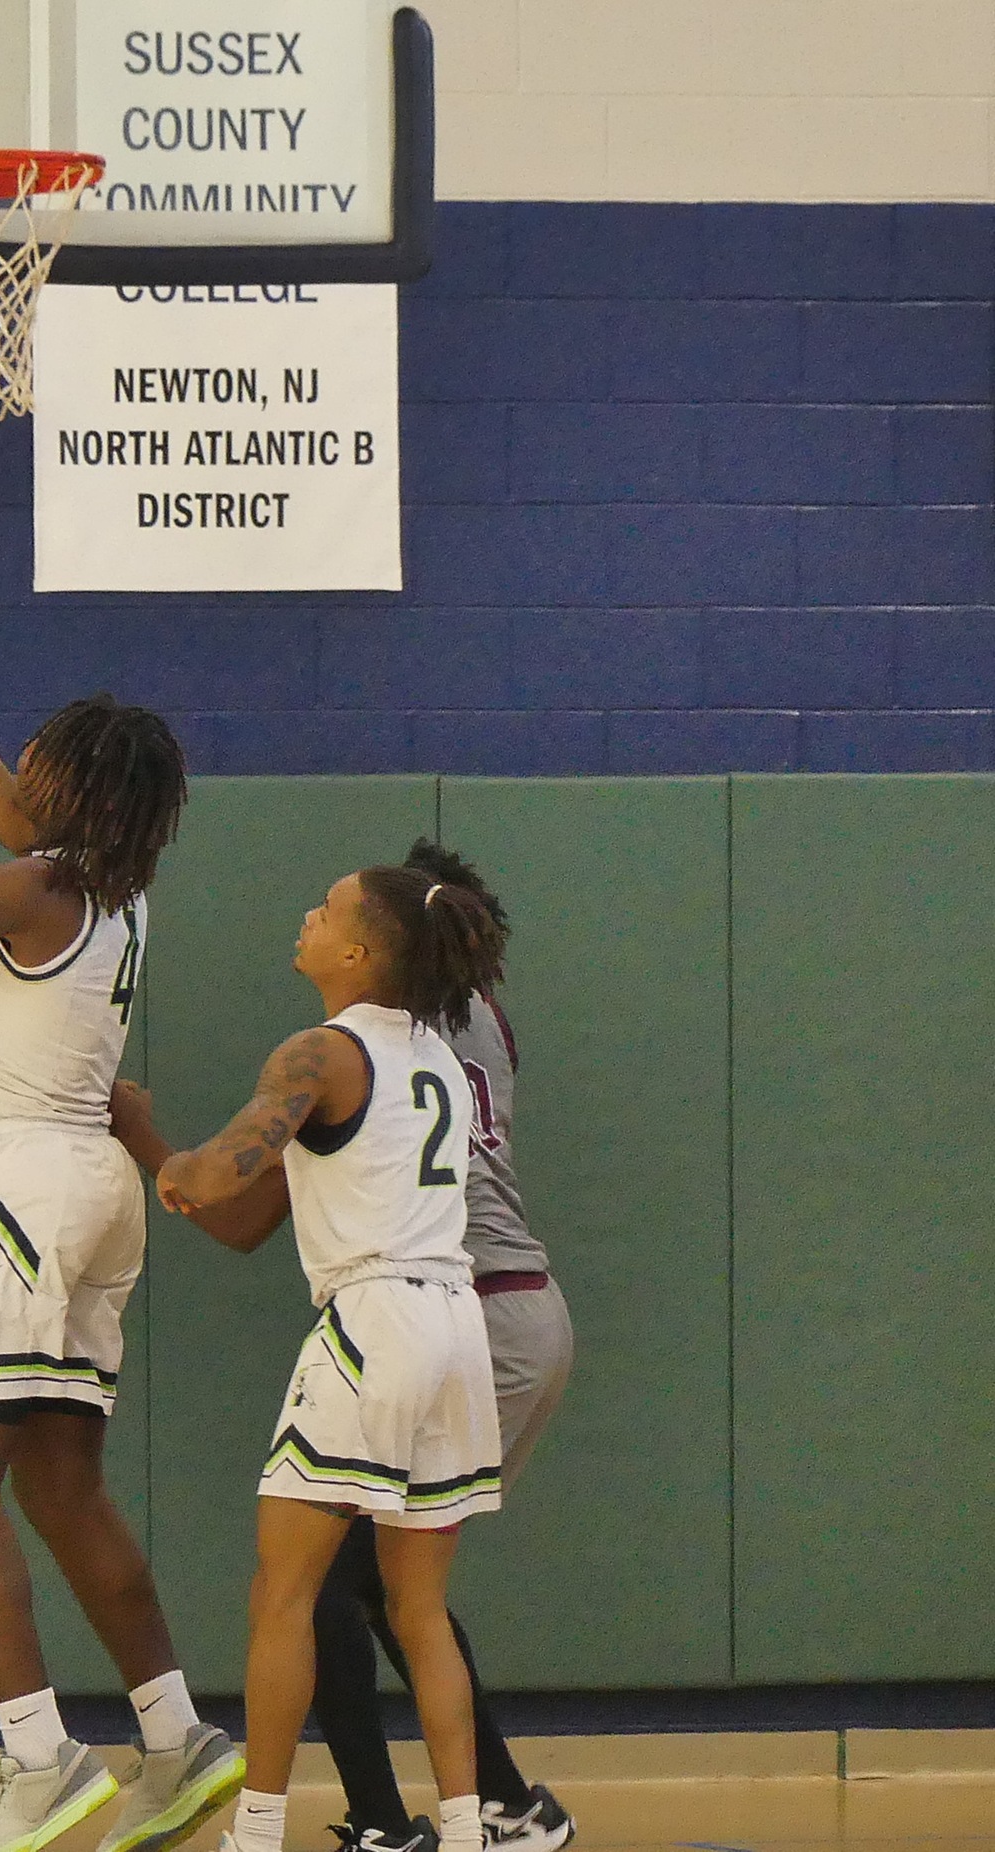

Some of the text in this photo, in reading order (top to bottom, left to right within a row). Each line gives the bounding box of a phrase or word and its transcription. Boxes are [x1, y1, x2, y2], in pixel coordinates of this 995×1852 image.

[124, 32, 303, 75] SUSSEX
[122, 108, 306, 151] COUNTY
[113, 368, 319, 410] NEWTON, NJ
[59, 430, 375, 465] NORTH ATLANTIC B
[138, 493, 290, 528] DISTRICT
[410, 1068, 458, 1188] 2
